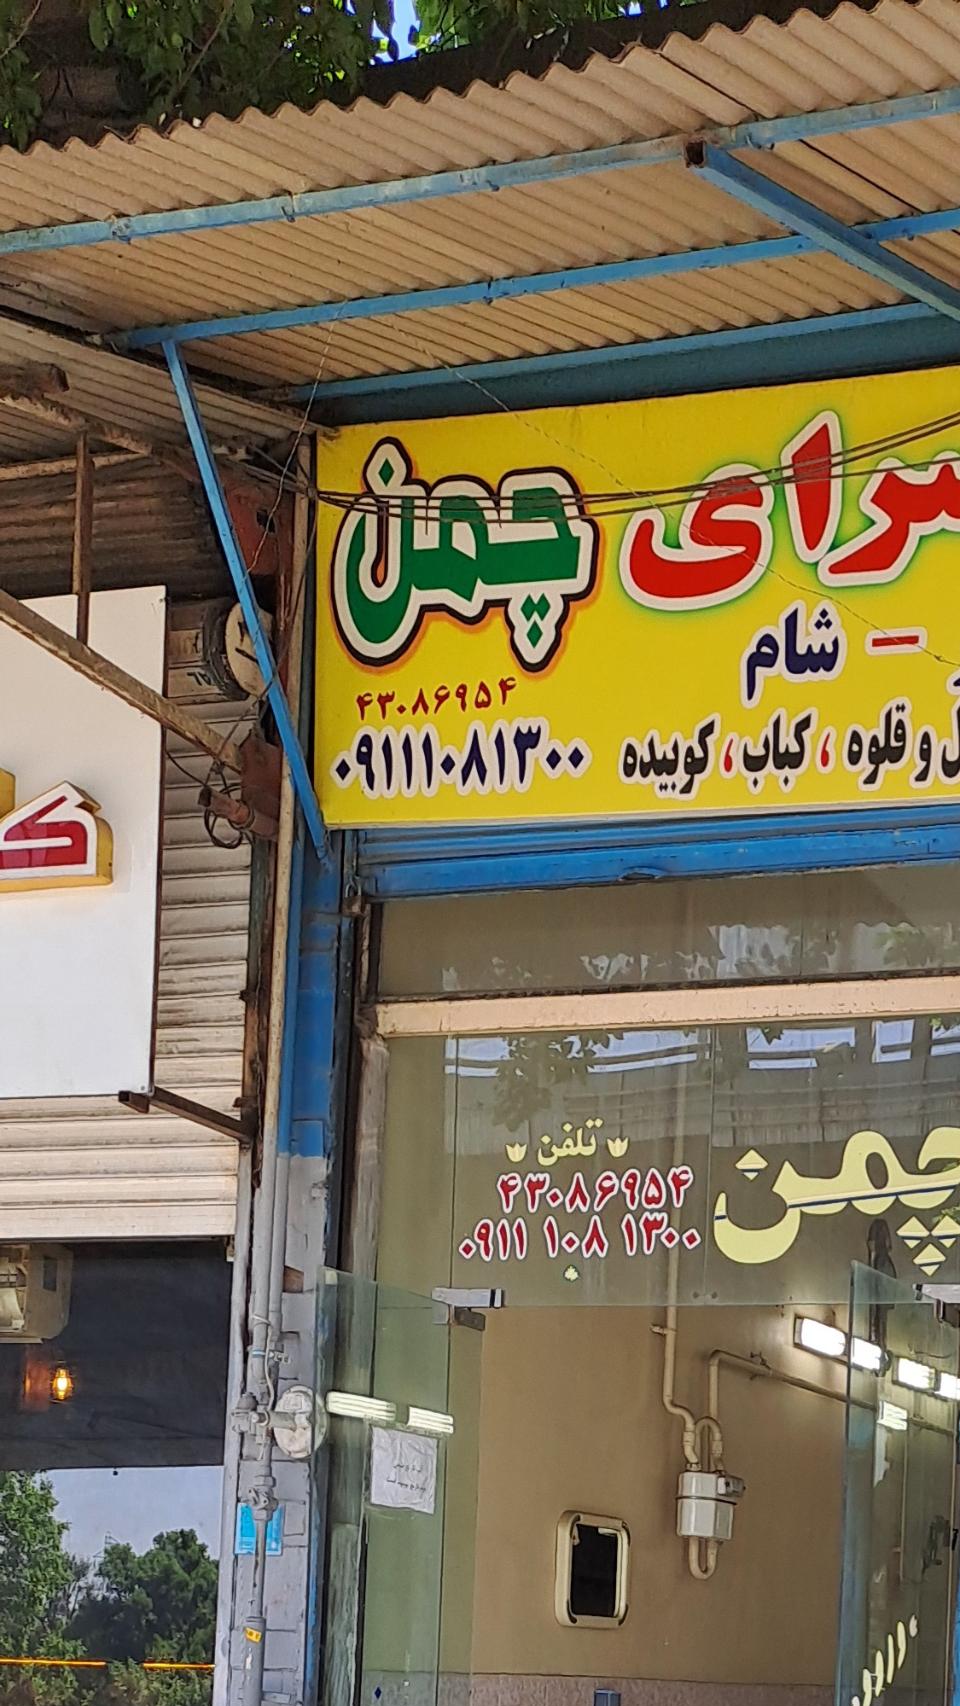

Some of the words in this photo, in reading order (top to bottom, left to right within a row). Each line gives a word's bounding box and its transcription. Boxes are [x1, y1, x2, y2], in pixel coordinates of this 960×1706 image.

[340, 450, 590, 658] چمن
[745, 606, 841, 702] شام
[356, 676, 517, 721] ۴۳۰۸۶۹۵۴
[335, 724, 585, 792] ۰۹۱۱۱۰۸۱۳۰۰
[622, 718, 716, 795] کوبیده
[914, 730, 932, 783] و
[536, 1116, 604, 1166] تلفن
[497, 1165, 694, 1213] ۴۳۰۸۶۹۵۴
